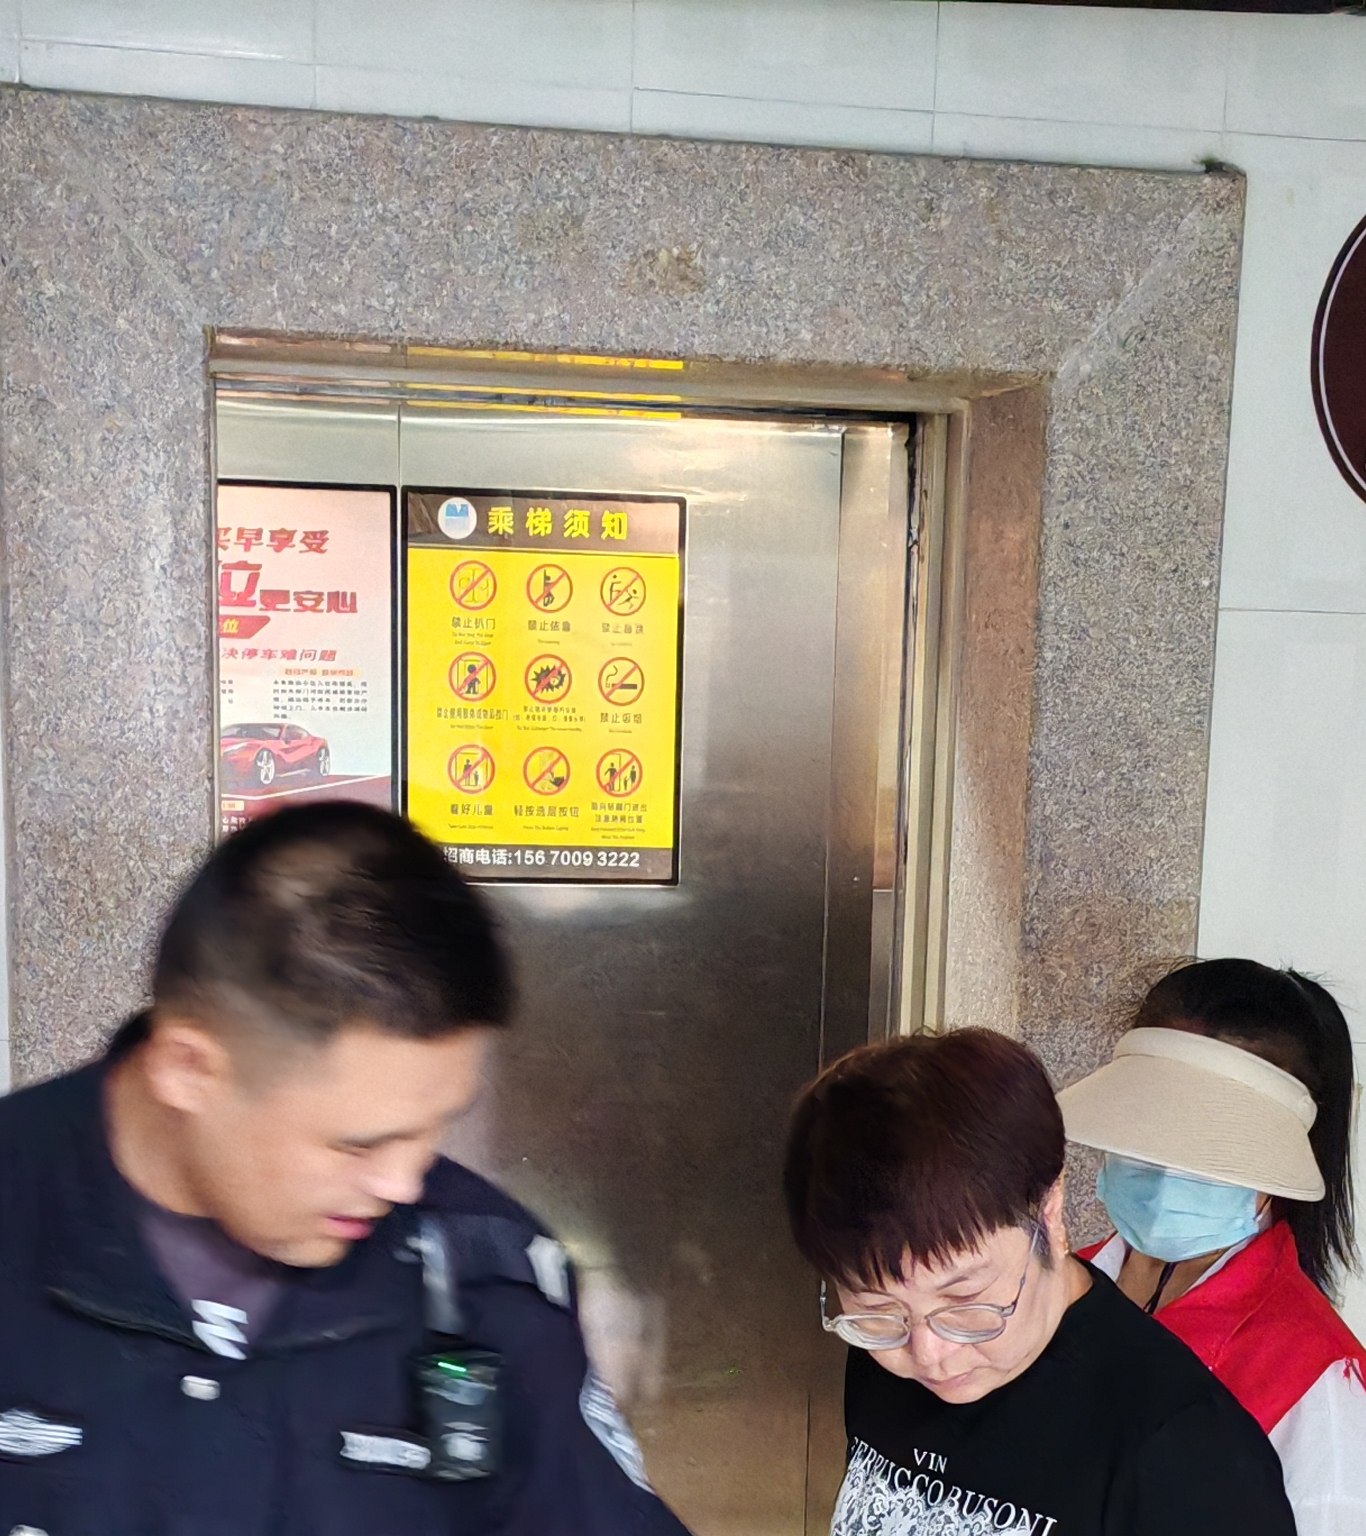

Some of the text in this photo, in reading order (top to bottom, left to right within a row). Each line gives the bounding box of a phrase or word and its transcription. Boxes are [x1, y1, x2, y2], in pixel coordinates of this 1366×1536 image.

[487, 505, 628, 541] 乘梯须知
[550, 850, 594, 867] 7009
[596, 851, 641, 868] 3222
[913, 1447, 949, 1475] VIN
